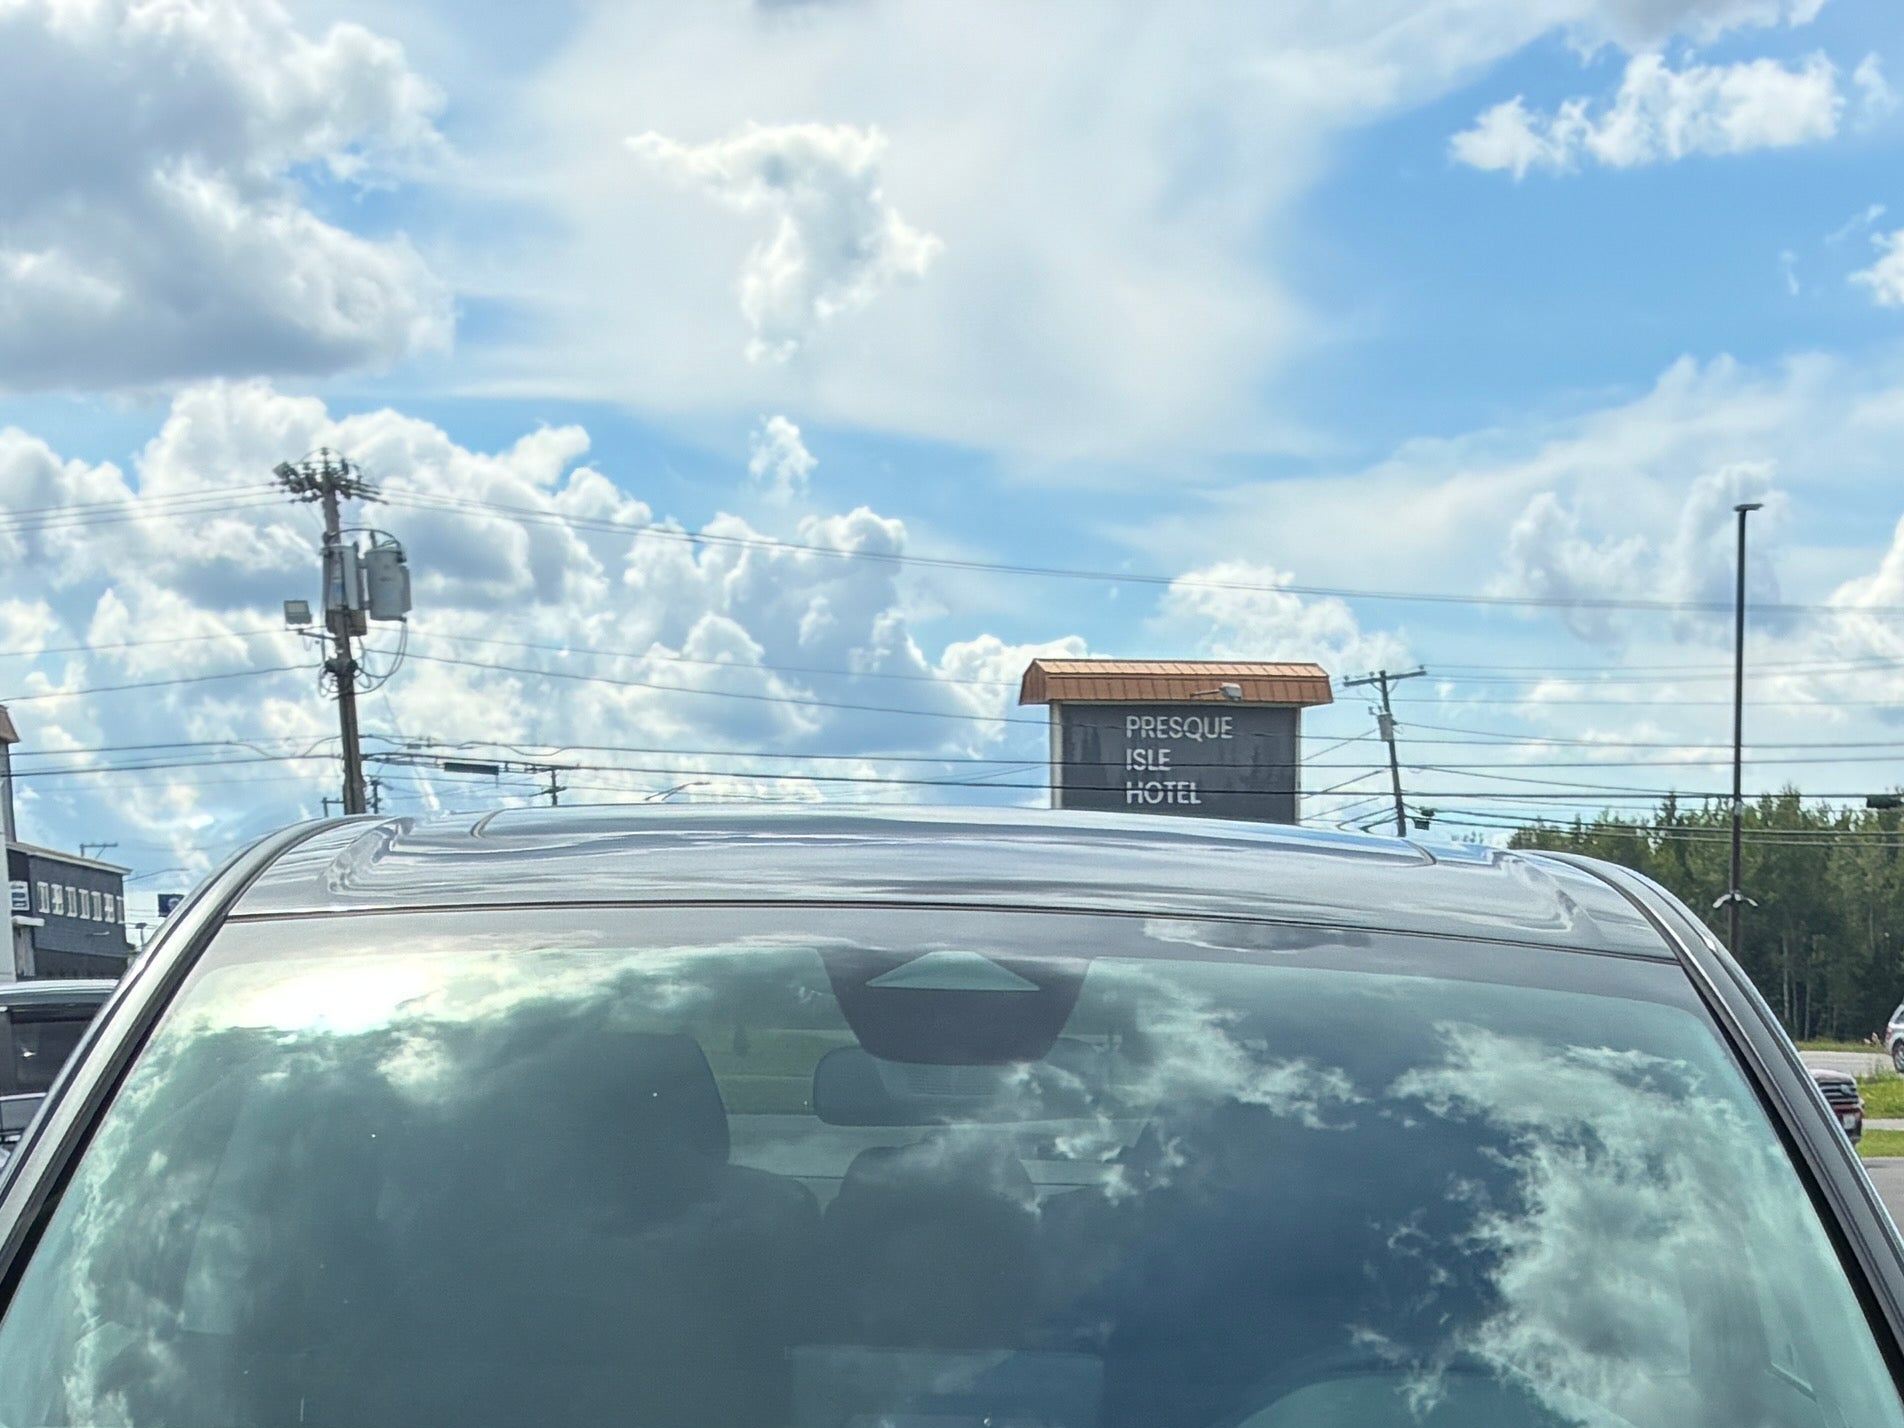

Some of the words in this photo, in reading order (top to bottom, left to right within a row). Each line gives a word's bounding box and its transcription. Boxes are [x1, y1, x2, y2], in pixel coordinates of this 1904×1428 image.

[1125, 715, 1233, 742] PRESQUE
[1125, 748, 1172, 772] ISLE
[1125, 780, 1202, 805] HOTEL
